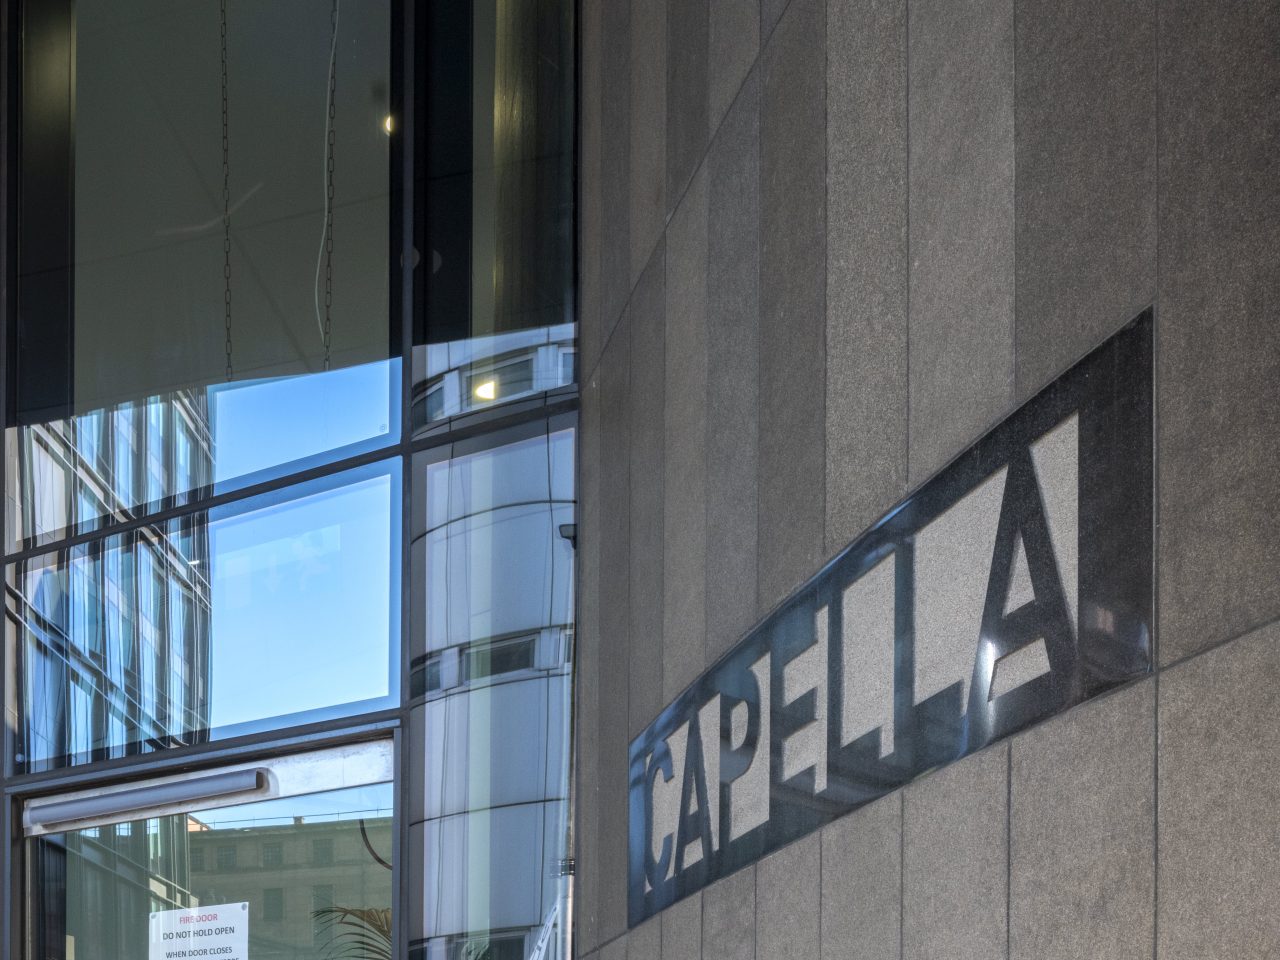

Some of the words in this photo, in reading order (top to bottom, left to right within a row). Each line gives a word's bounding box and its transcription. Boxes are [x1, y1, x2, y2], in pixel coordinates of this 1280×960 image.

[643, 425, 1081, 896] CAPELLA
[179, 916, 194, 925] FIRE
[195, 913, 218, 923] DOOR
[162, 932, 174, 941] DO
[175, 930, 191, 939] NOT
[192, 928, 213, 938] HOLD
[214, 926, 235, 935] OPEN
[165, 950, 187, 959] WHEN
[188, 948, 208, 957] DOOR
[208, 946, 233, 955] CLOSES
